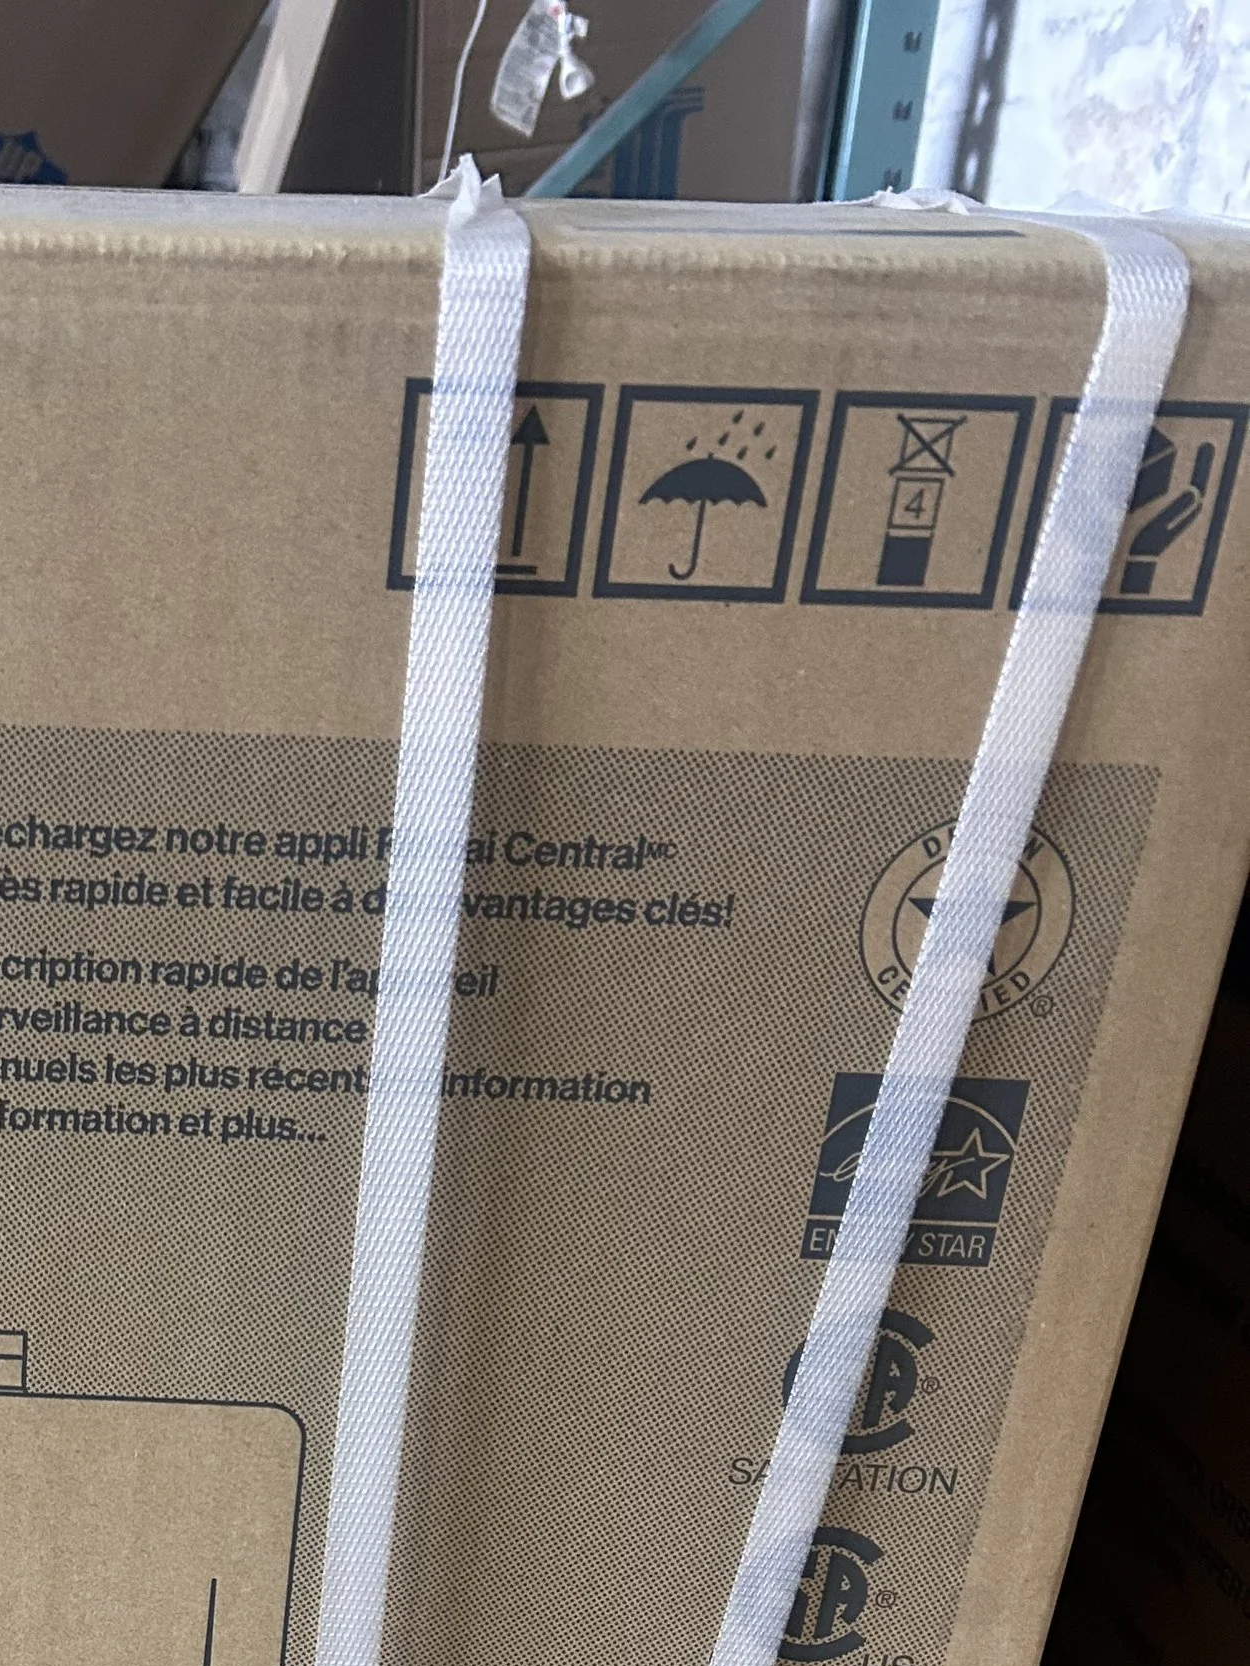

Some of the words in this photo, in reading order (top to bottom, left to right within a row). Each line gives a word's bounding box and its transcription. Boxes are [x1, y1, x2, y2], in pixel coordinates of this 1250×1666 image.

[904, 487, 925, 520] 4
[165, 823, 266, 857] notre
[273, 826, 368, 866] appli
[49, 870, 169, 911] rapide
[175, 874, 213, 909] et
[222, 875, 325, 913] facile
[330, 879, 355, 914] à
[461, 886, 637, 931] vantages
[644, 890, 737, 930] clés!
[150, 955, 268, 992] rapide
[275, 958, 323, 991] de
[179, 1006, 202, 1038] à
[208, 1007, 369, 1045] distance
[106, 1052, 157, 1087] les
[163, 1055, 242, 1093] plus
[250, 1059, 368, 1095] récent
[442, 1066, 652, 1104] information
[178, 1110, 213, 1138] et
[221, 1108, 328, 1145] plus...
[917, 1231, 987, 1260] STAR
[728, 1457, 959, 1495] SAATION
